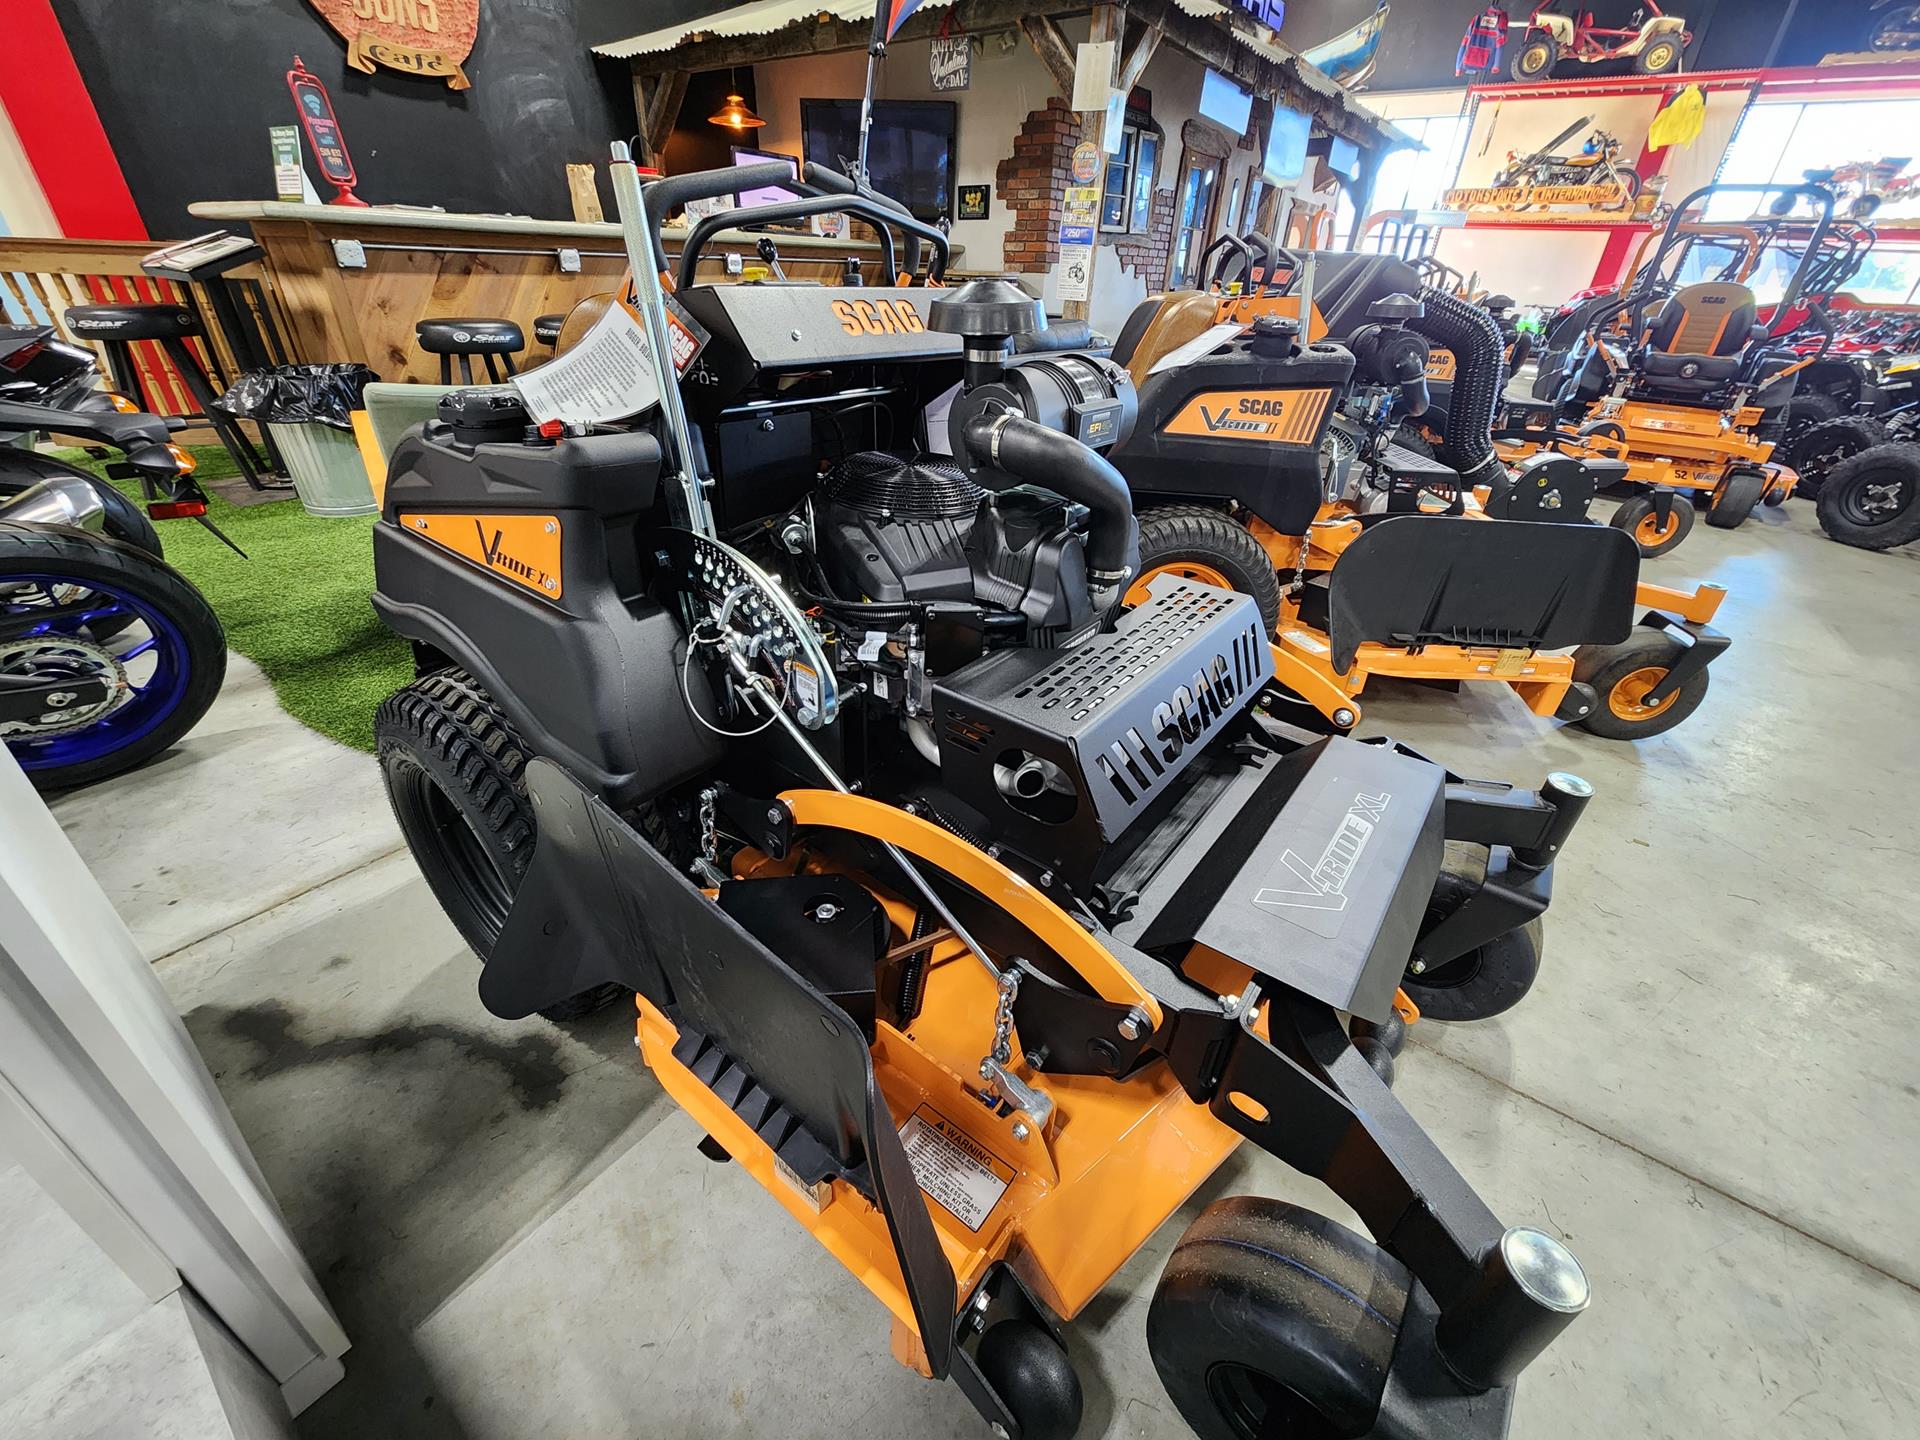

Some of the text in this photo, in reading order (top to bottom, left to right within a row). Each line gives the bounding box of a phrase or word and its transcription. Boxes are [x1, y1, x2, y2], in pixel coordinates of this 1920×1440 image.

[368, 44, 443, 71] Café
[950, 69, 966, 87] DAY
[1538, 184, 1622, 202] INTERNATIONAL
[1701, 296, 1726, 304] SCAG
[77, 319, 129, 328] Star
[832, 299, 924, 336] SCAG
[472, 334, 515, 342] Star
[1430, 355, 1449, 365] CAG
[1239, 399, 1283, 416] SCAG
[1674, 469, 1688, 480] 52
[1152, 654, 1235, 763] SCAG
[1349, 792, 1392, 823] XL
[917, 1122, 996, 1183] ROTATING BLADES AND BELTS
[945, 1128, 992, 1165] WARNING
[914, 1160, 939, 1179] OPERATE
[939, 1180, 961, 1198] UNLESS
[962, 1197, 981, 1213] GRASS
[917, 1179, 936, 1194] CHUTE
[921, 1174, 951, 1197] MULCHING
[951, 1197, 962, 1206] KIT
[961, 1205, 971, 1214] OR
